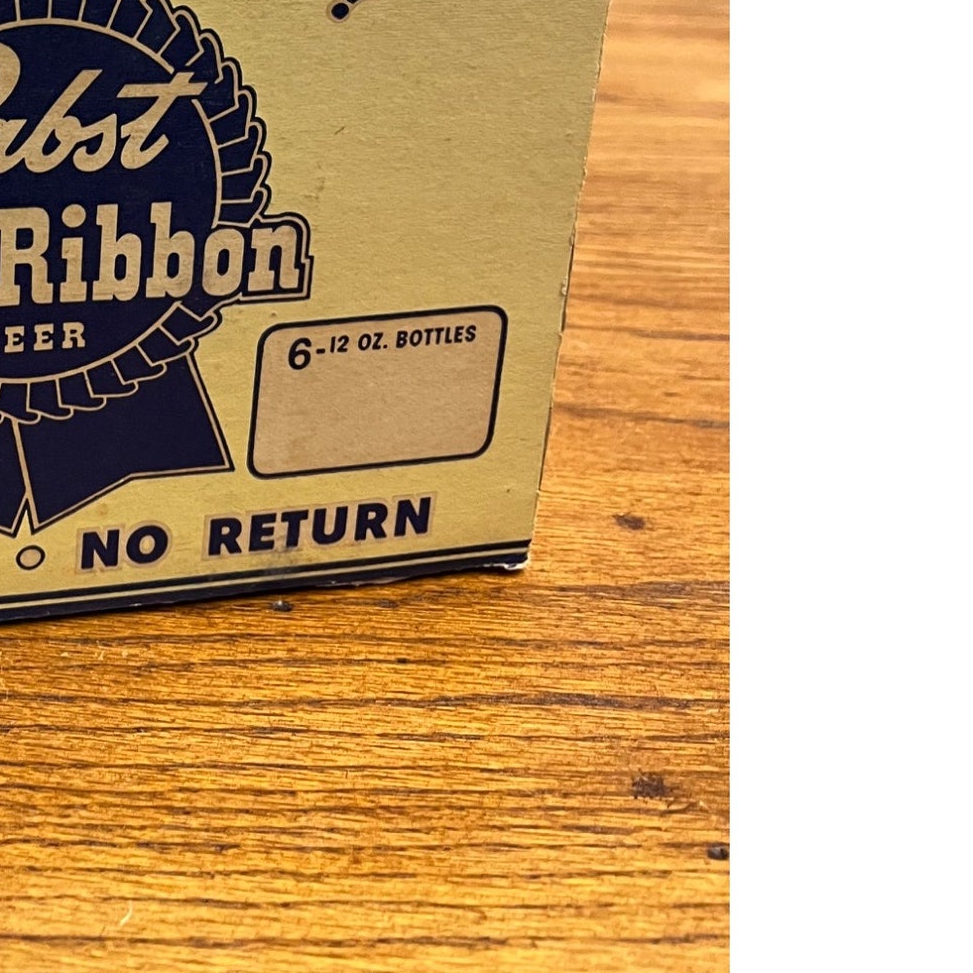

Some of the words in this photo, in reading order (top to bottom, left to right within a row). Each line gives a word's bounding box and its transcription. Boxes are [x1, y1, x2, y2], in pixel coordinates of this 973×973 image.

[357, 332, 388, 351] OZ.
[395, 324, 477, 349] BOTTLES
[80, 524, 170, 569] NO
[207, 496, 432, 556] RETURN
